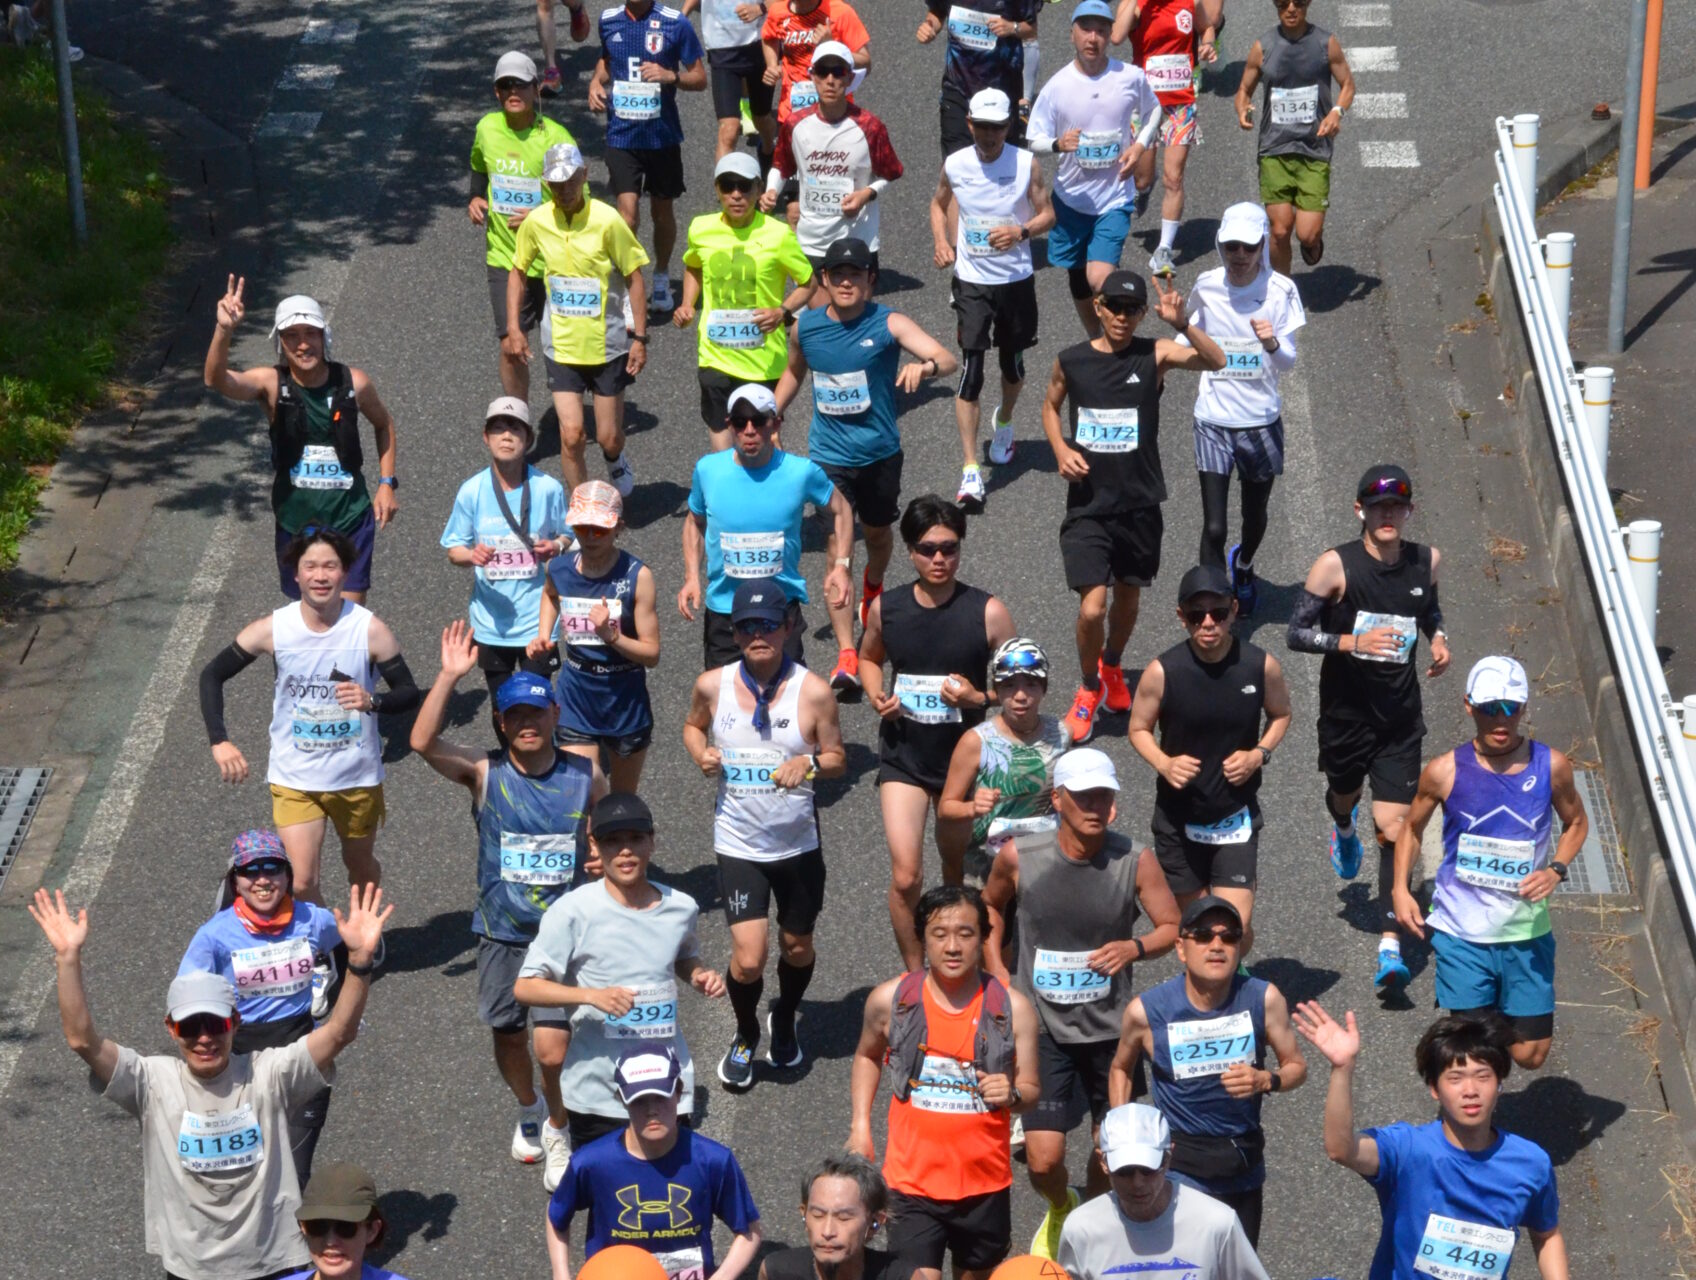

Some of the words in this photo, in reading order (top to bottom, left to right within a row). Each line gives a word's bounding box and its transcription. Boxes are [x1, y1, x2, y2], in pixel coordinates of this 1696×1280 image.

[784, 30, 815, 44] JAPA
[806, 150, 851, 163] AOMORI
[495, 158, 531, 176] ひろし
[806, 163, 850, 177] SAKURA
[504, 190, 534, 204] 263
[828, 387, 862, 403] 364
[490, 550, 538, 566] 4311
[310, 721, 351, 737] 449
[503, 853, 574, 869] C1268
[1458, 855, 1531, 877] C1466
[1041, 953, 1059, 964] TEL
[238, 958, 312, 987] C4118
[630, 1003, 674, 1022] 392
[1173, 1035, 1251, 1062] C2577
[180, 1128, 259, 1154] D1183
[1436, 1219, 1457, 1235] TEL
[1422, 1243, 1434, 1256] D
[1446, 1246, 1498, 1270] 448
